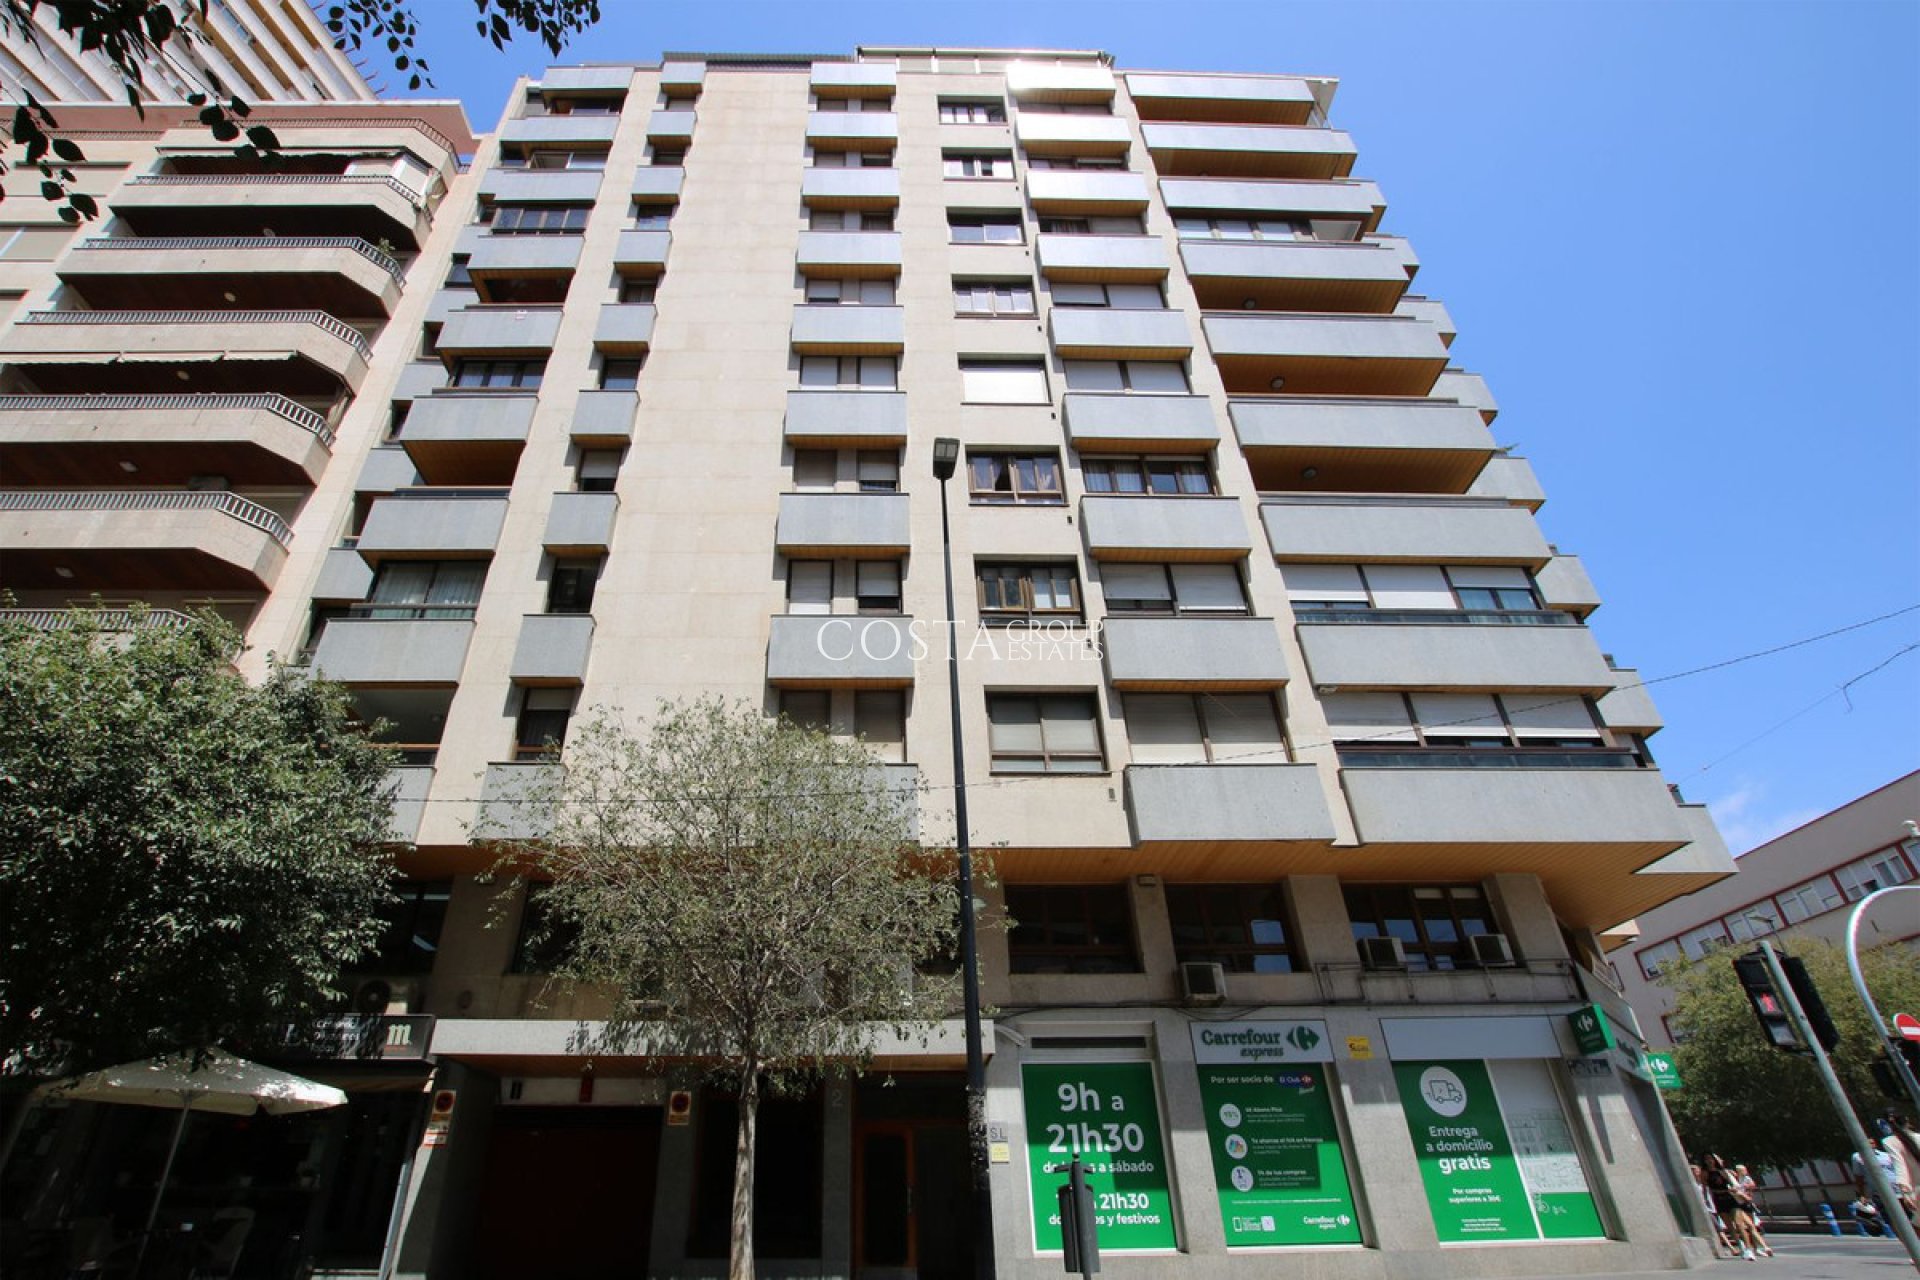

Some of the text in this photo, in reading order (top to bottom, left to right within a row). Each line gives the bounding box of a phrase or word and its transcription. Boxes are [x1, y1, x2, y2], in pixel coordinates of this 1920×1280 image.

[1201, 1027, 1281, 1046] Carrefour
[1240, 1047, 1284, 1061] express
[1210, 1075, 1225, 1083] Por
[1057, 1081, 1124, 1112] 9h a
[1045, 1122, 1144, 1154] 21h30
[1428, 1126, 1478, 1138] Entrega
[1425, 1138, 1494, 1152] a domicilio
[1098, 1163, 1106, 1172] a
[1108, 1159, 1154, 1172] sábado
[1438, 1153, 1492, 1175] gratis
[1099, 1193, 1149, 1209] 21h30
[1107, 1214, 1114, 1227] y
[1116, 1212, 1160, 1225] festivos
